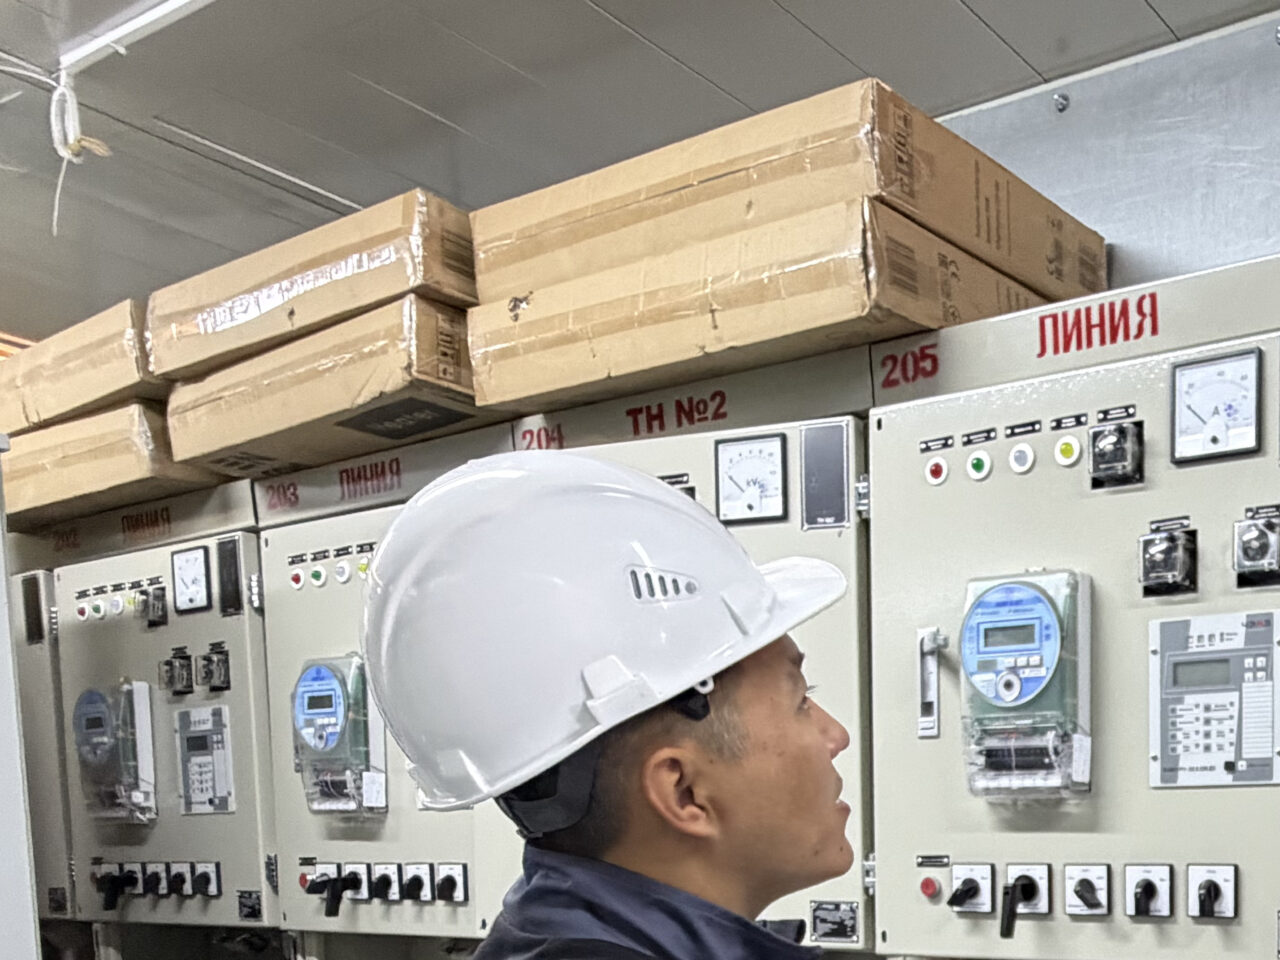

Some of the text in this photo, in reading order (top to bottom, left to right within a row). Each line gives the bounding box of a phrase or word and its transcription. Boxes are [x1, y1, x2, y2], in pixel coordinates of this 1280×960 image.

[880, 343, 939, 389] 205
[1036, 291, 1160, 359] ЛИНИЯ
[626, 405, 665, 437] ТН
[675, 389, 729, 429] №2
[266, 481, 299, 510] 203
